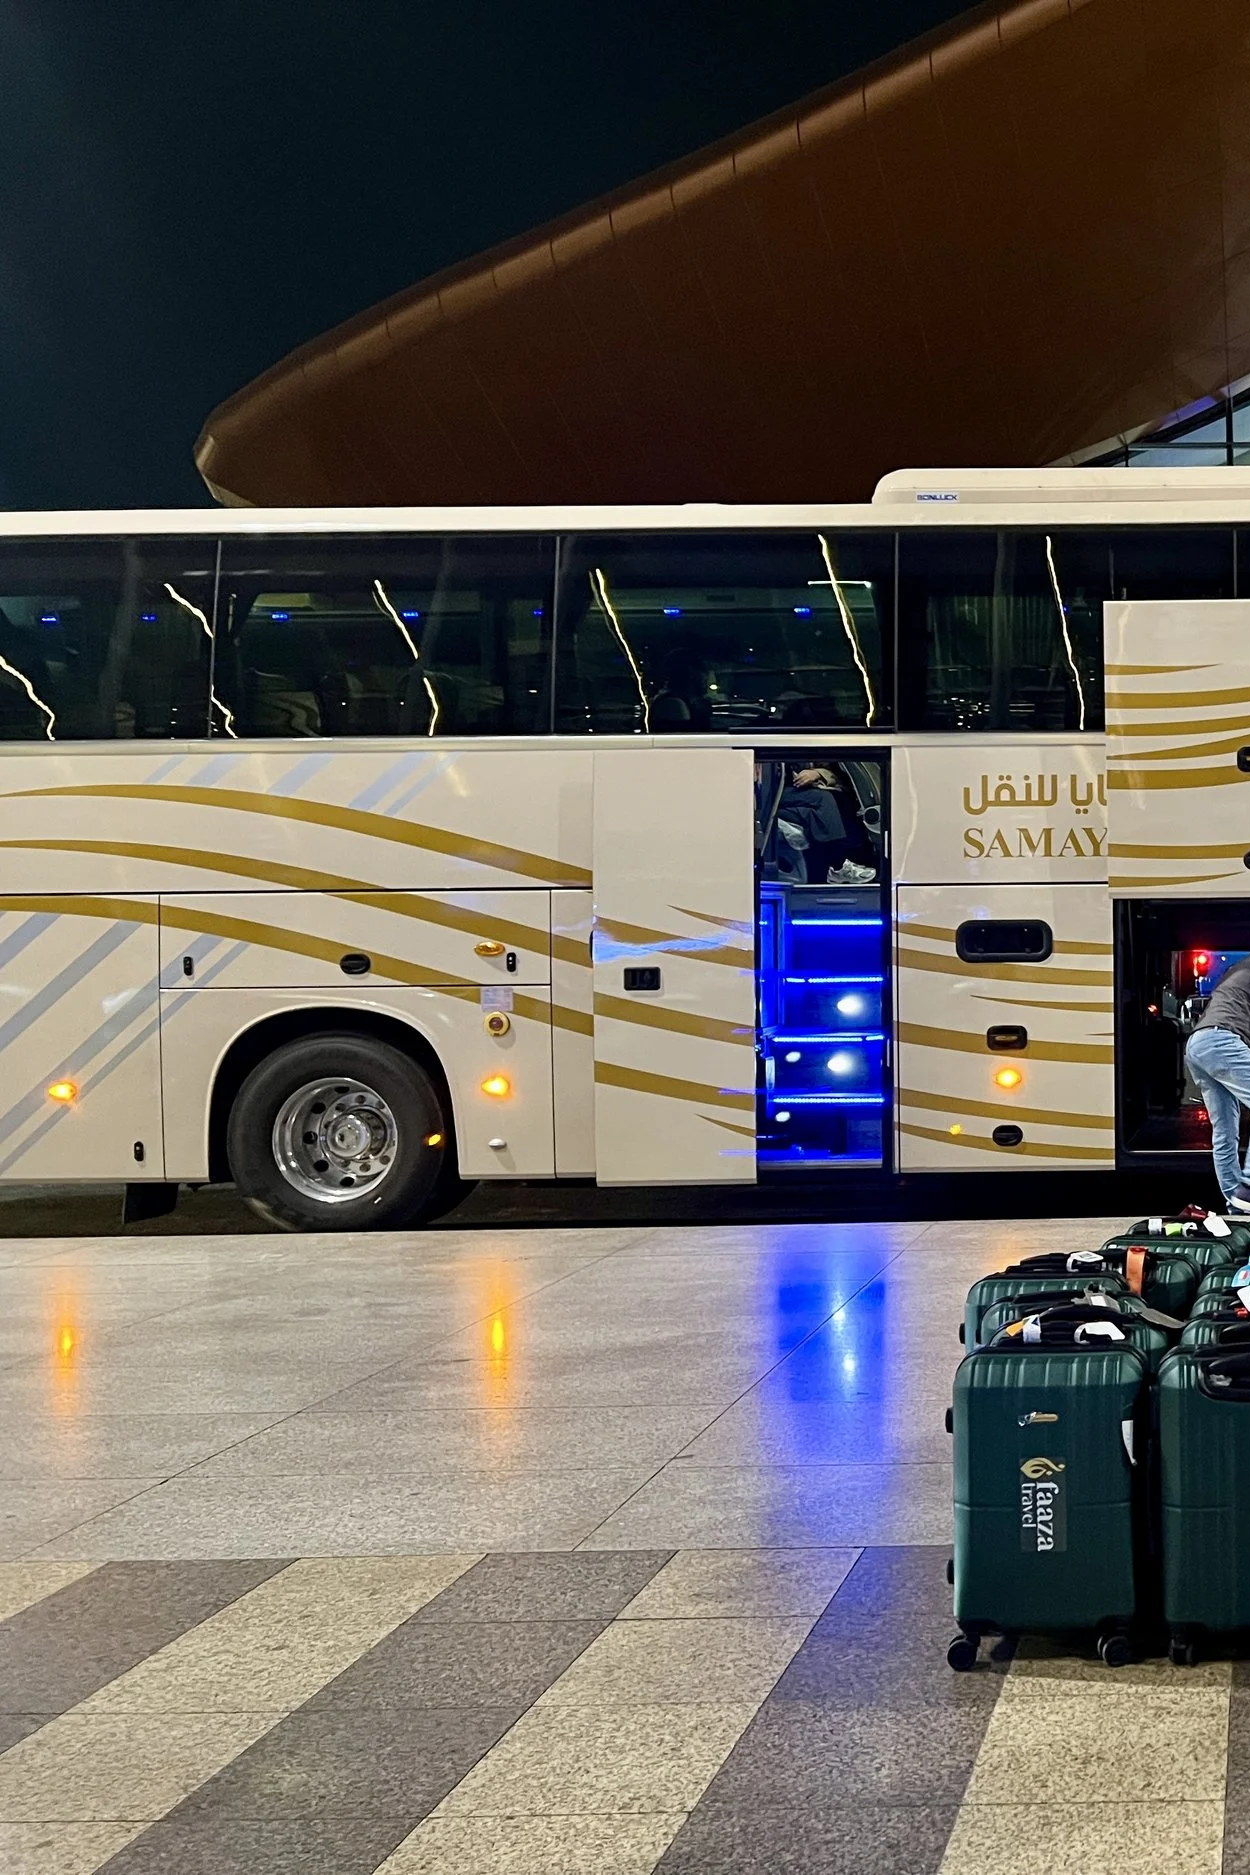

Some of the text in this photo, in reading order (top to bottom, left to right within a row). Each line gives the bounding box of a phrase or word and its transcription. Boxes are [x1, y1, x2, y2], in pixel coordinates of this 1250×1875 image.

[963, 774, 1058, 815] للنقل
[963, 827, 1108, 859] SAMAY
[1021, 1482, 1037, 1528] travel
[1036, 1481, 1060, 1552] faaza
